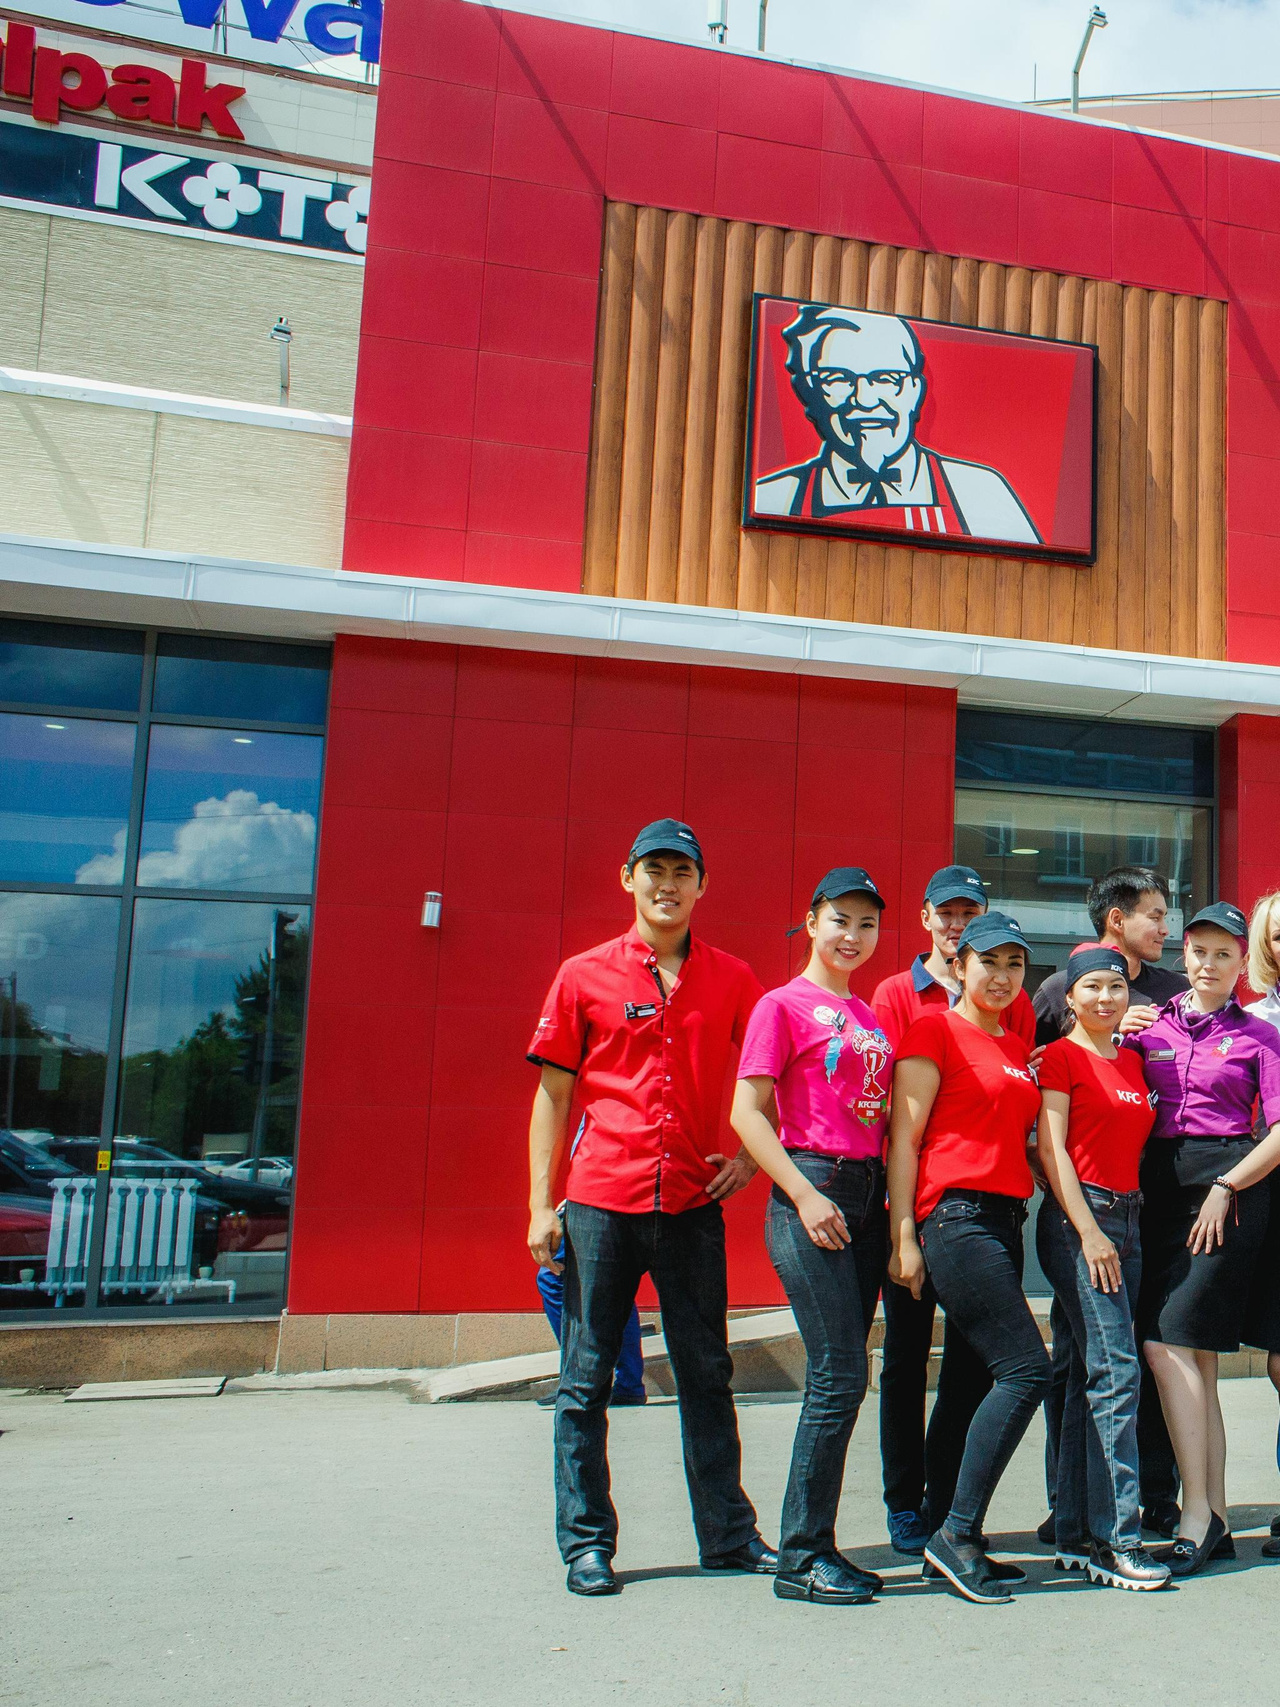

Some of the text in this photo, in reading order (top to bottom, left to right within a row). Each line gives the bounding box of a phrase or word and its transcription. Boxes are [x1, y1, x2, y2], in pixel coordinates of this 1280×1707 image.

[0, 22, 246, 140] lpak
[1110, 964, 1123, 974] KFC
[1002, 1064, 1031, 1082] KFC
[1116, 1089, 1142, 1105] KFC
